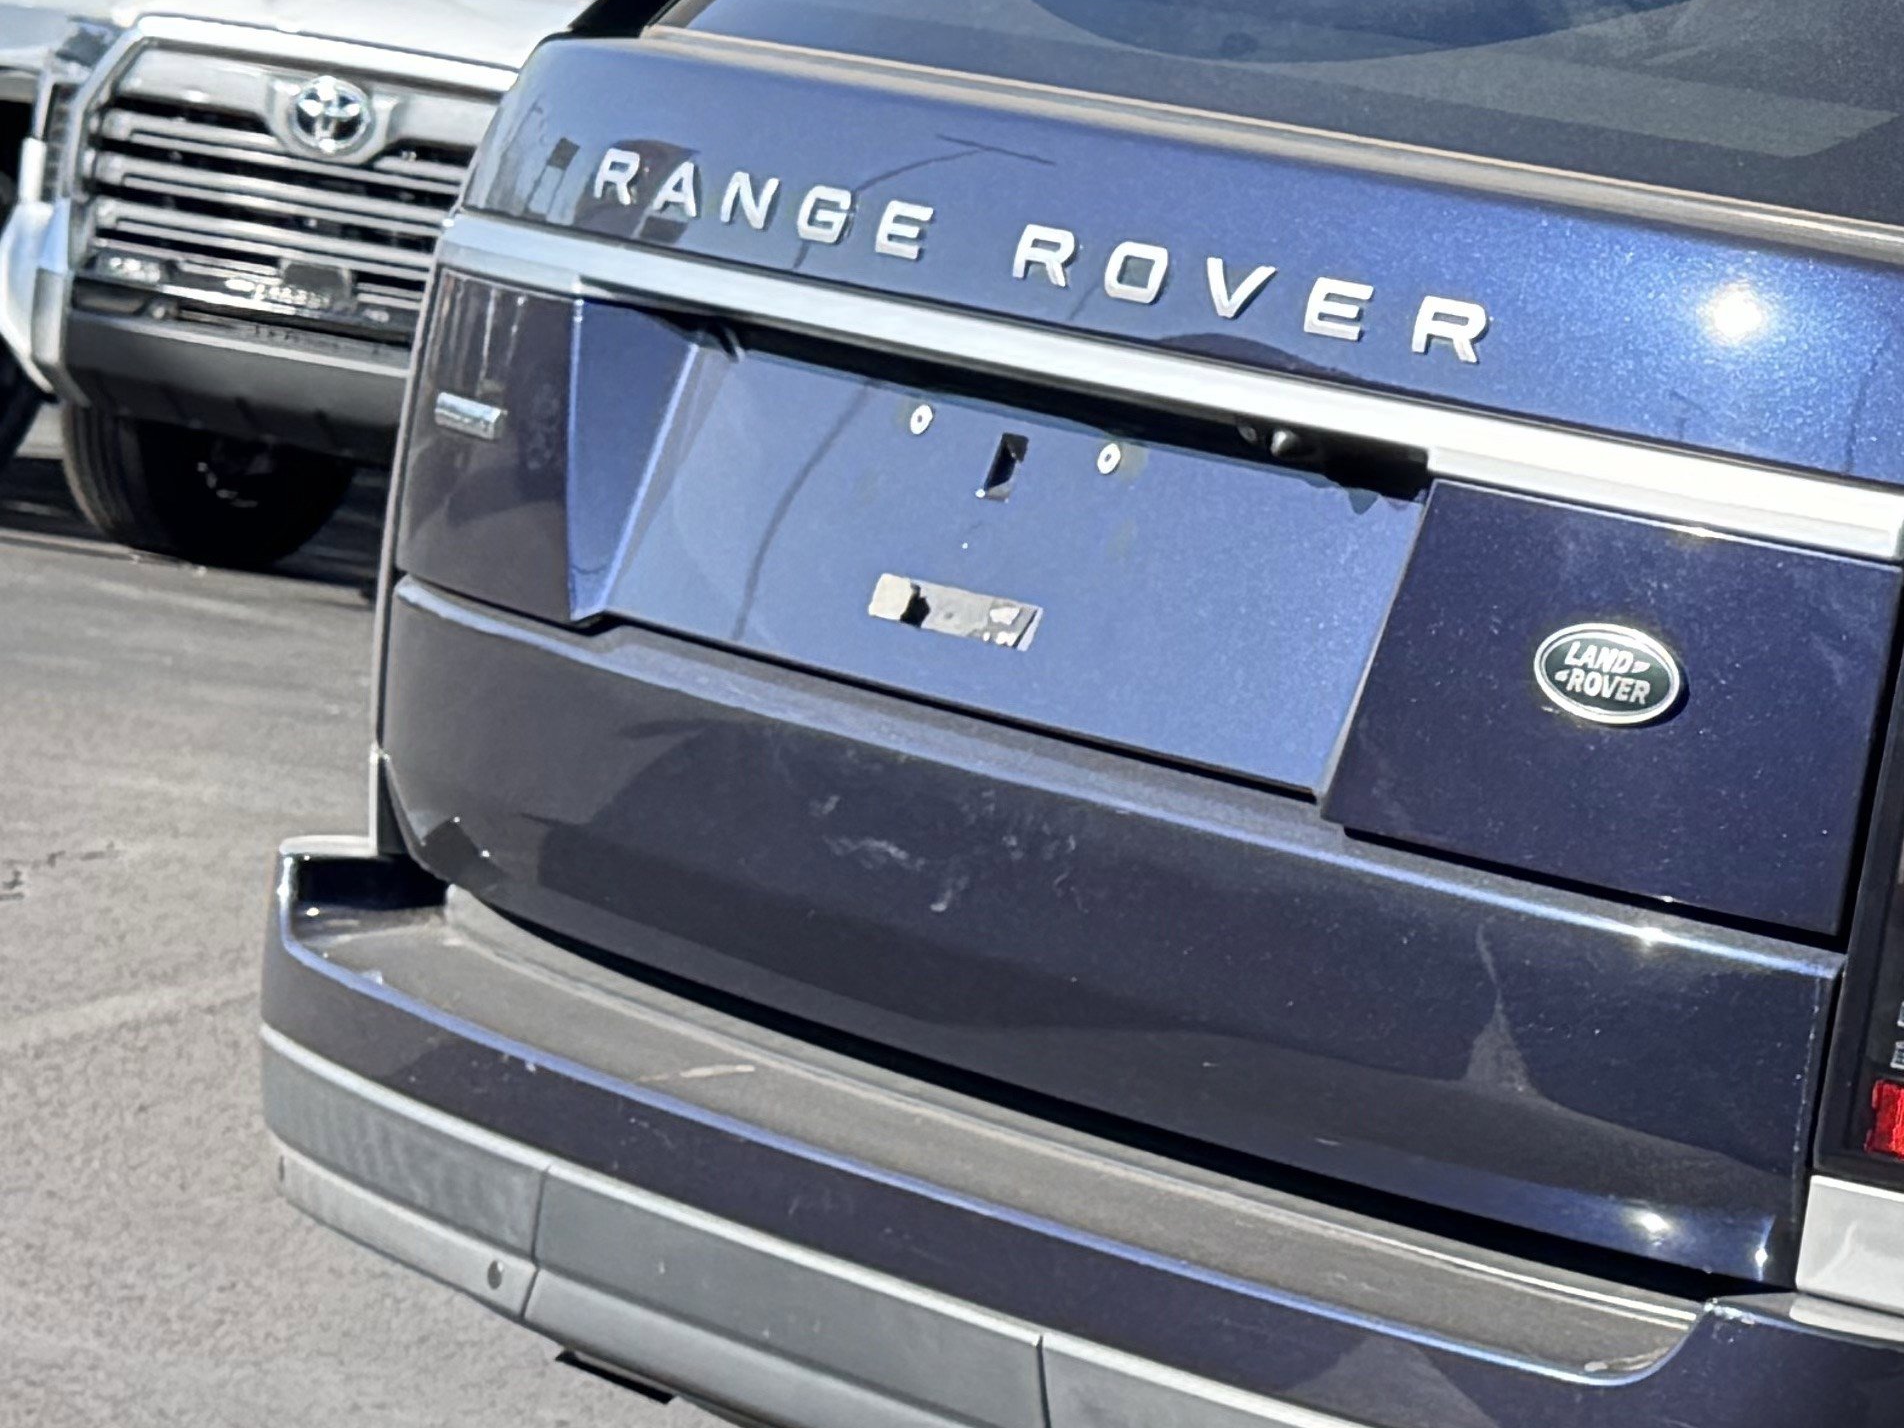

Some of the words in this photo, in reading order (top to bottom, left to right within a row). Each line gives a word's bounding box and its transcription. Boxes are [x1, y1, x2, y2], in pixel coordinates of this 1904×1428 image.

[593, 148, 934, 260] RANGE
[1012, 223, 1488, 363] ROVER
[1564, 641, 1634, 675] LAND
[1565, 668, 1651, 705] ROVER
